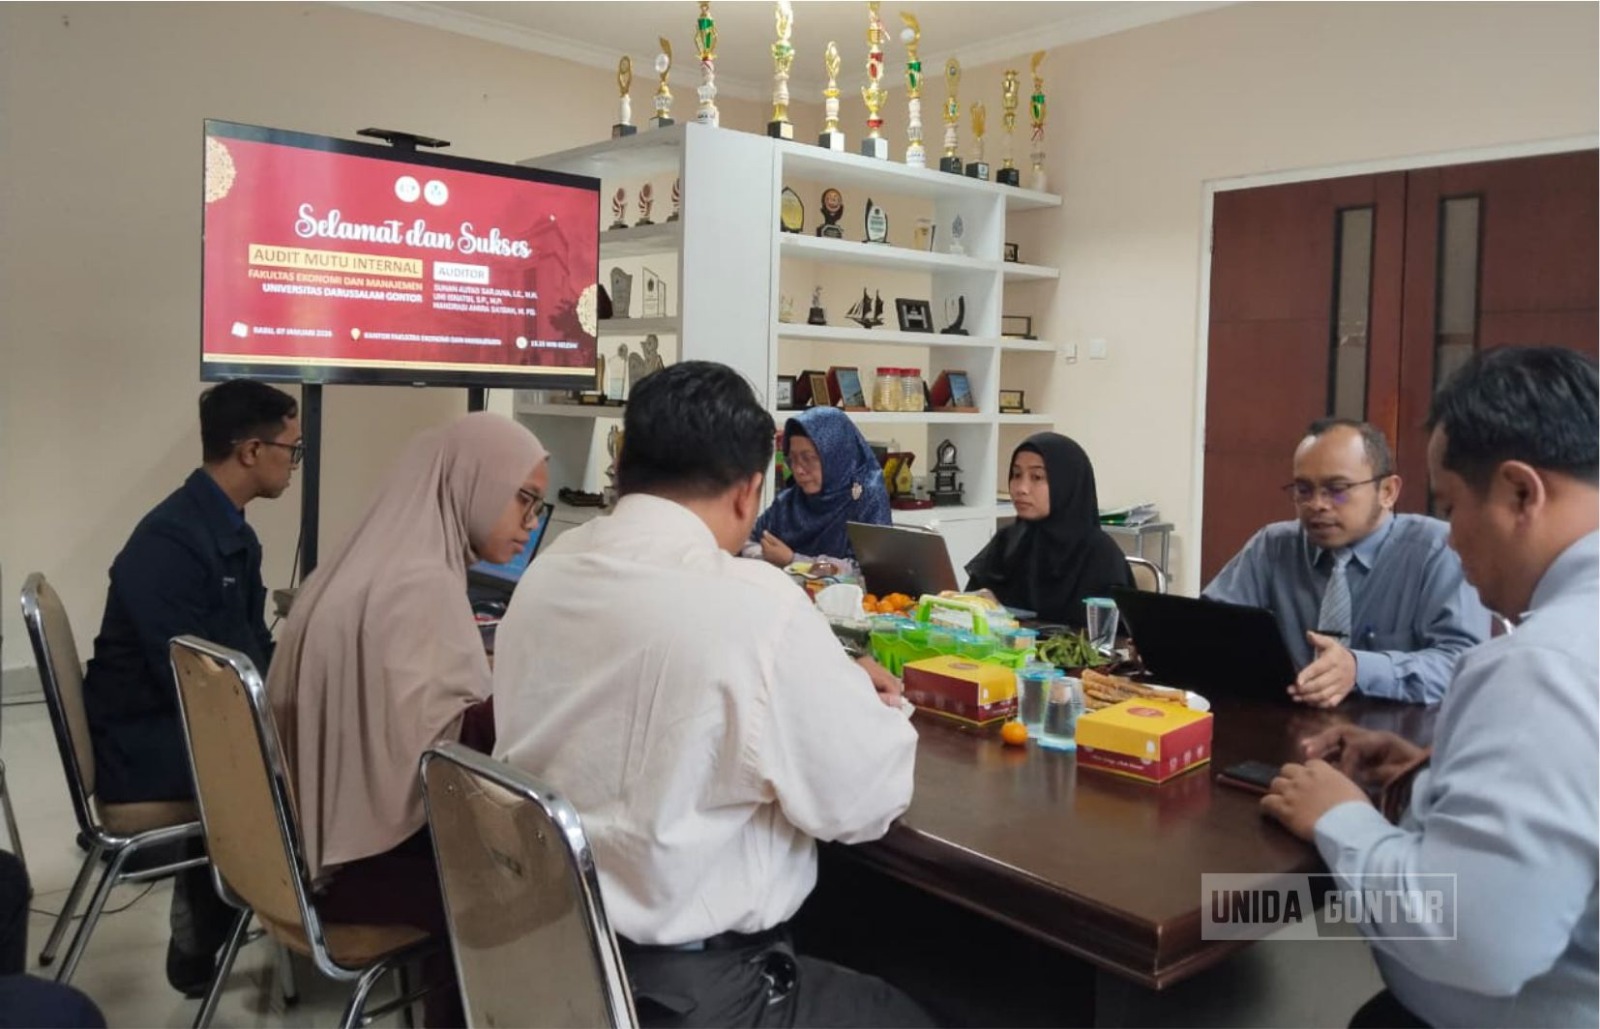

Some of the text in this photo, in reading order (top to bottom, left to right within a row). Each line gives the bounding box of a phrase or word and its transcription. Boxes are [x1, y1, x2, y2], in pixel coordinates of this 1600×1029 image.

[295, 203, 533, 259] Selamat dan Sukses
[253, 248, 418, 275] AUDIT MUTU INTERNAL
[438, 266, 485, 279] AUDITOR
[248, 269, 423, 291] FAKULTAS EKONOMI DAN MANAJEMEN
[262, 283, 423, 303] UNIVERSITAS DARUSSALAM GONTOR
